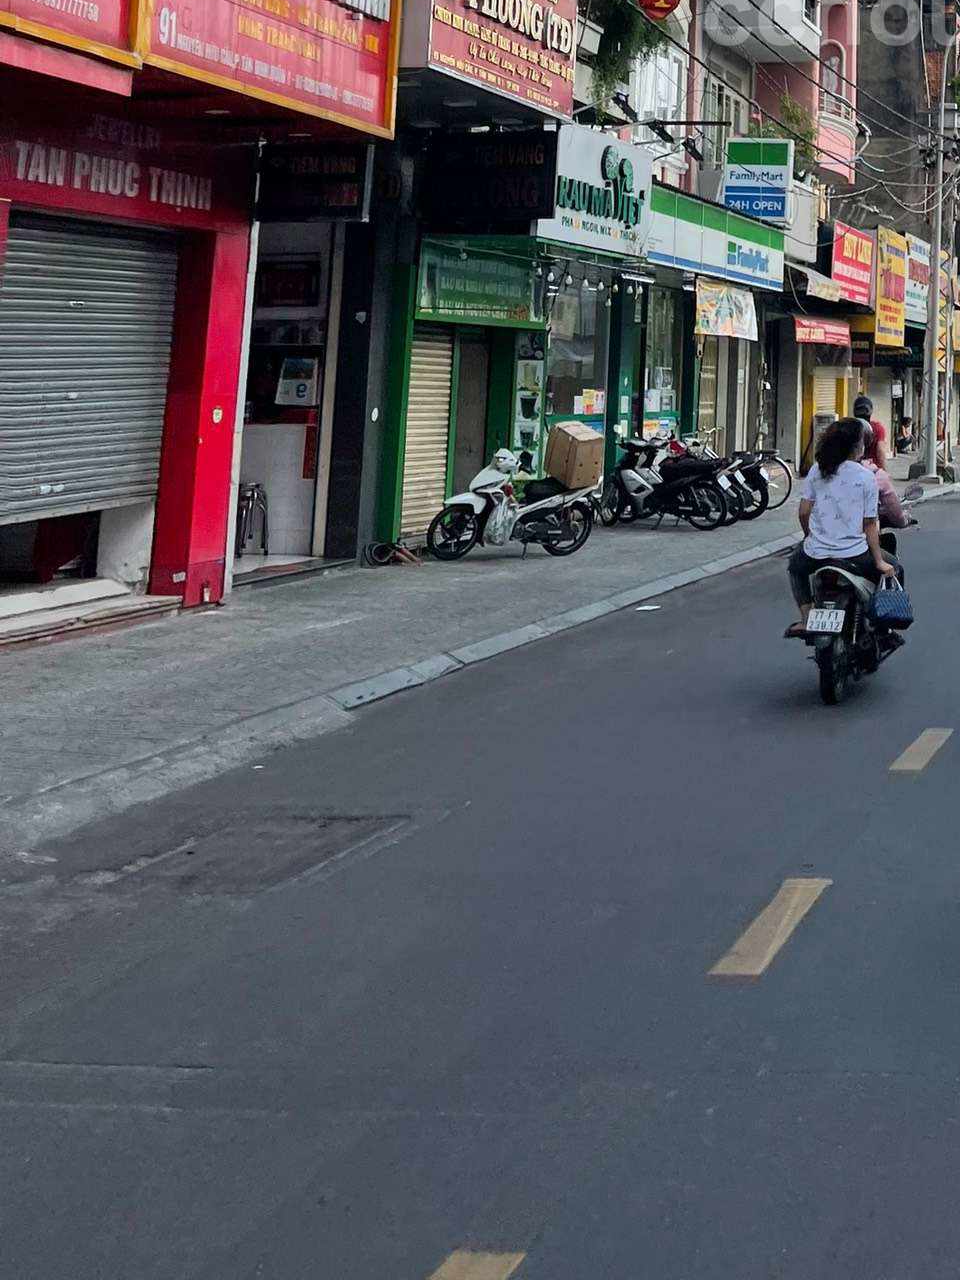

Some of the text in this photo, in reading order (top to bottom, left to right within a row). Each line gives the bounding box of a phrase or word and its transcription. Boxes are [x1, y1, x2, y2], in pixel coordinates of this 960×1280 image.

[159, 6, 178, 48] 91
[730, 170, 783, 182] FamilyMart
[556, 175, 588, 212] RAU
[728, 200, 782, 211] 24H OPEN
